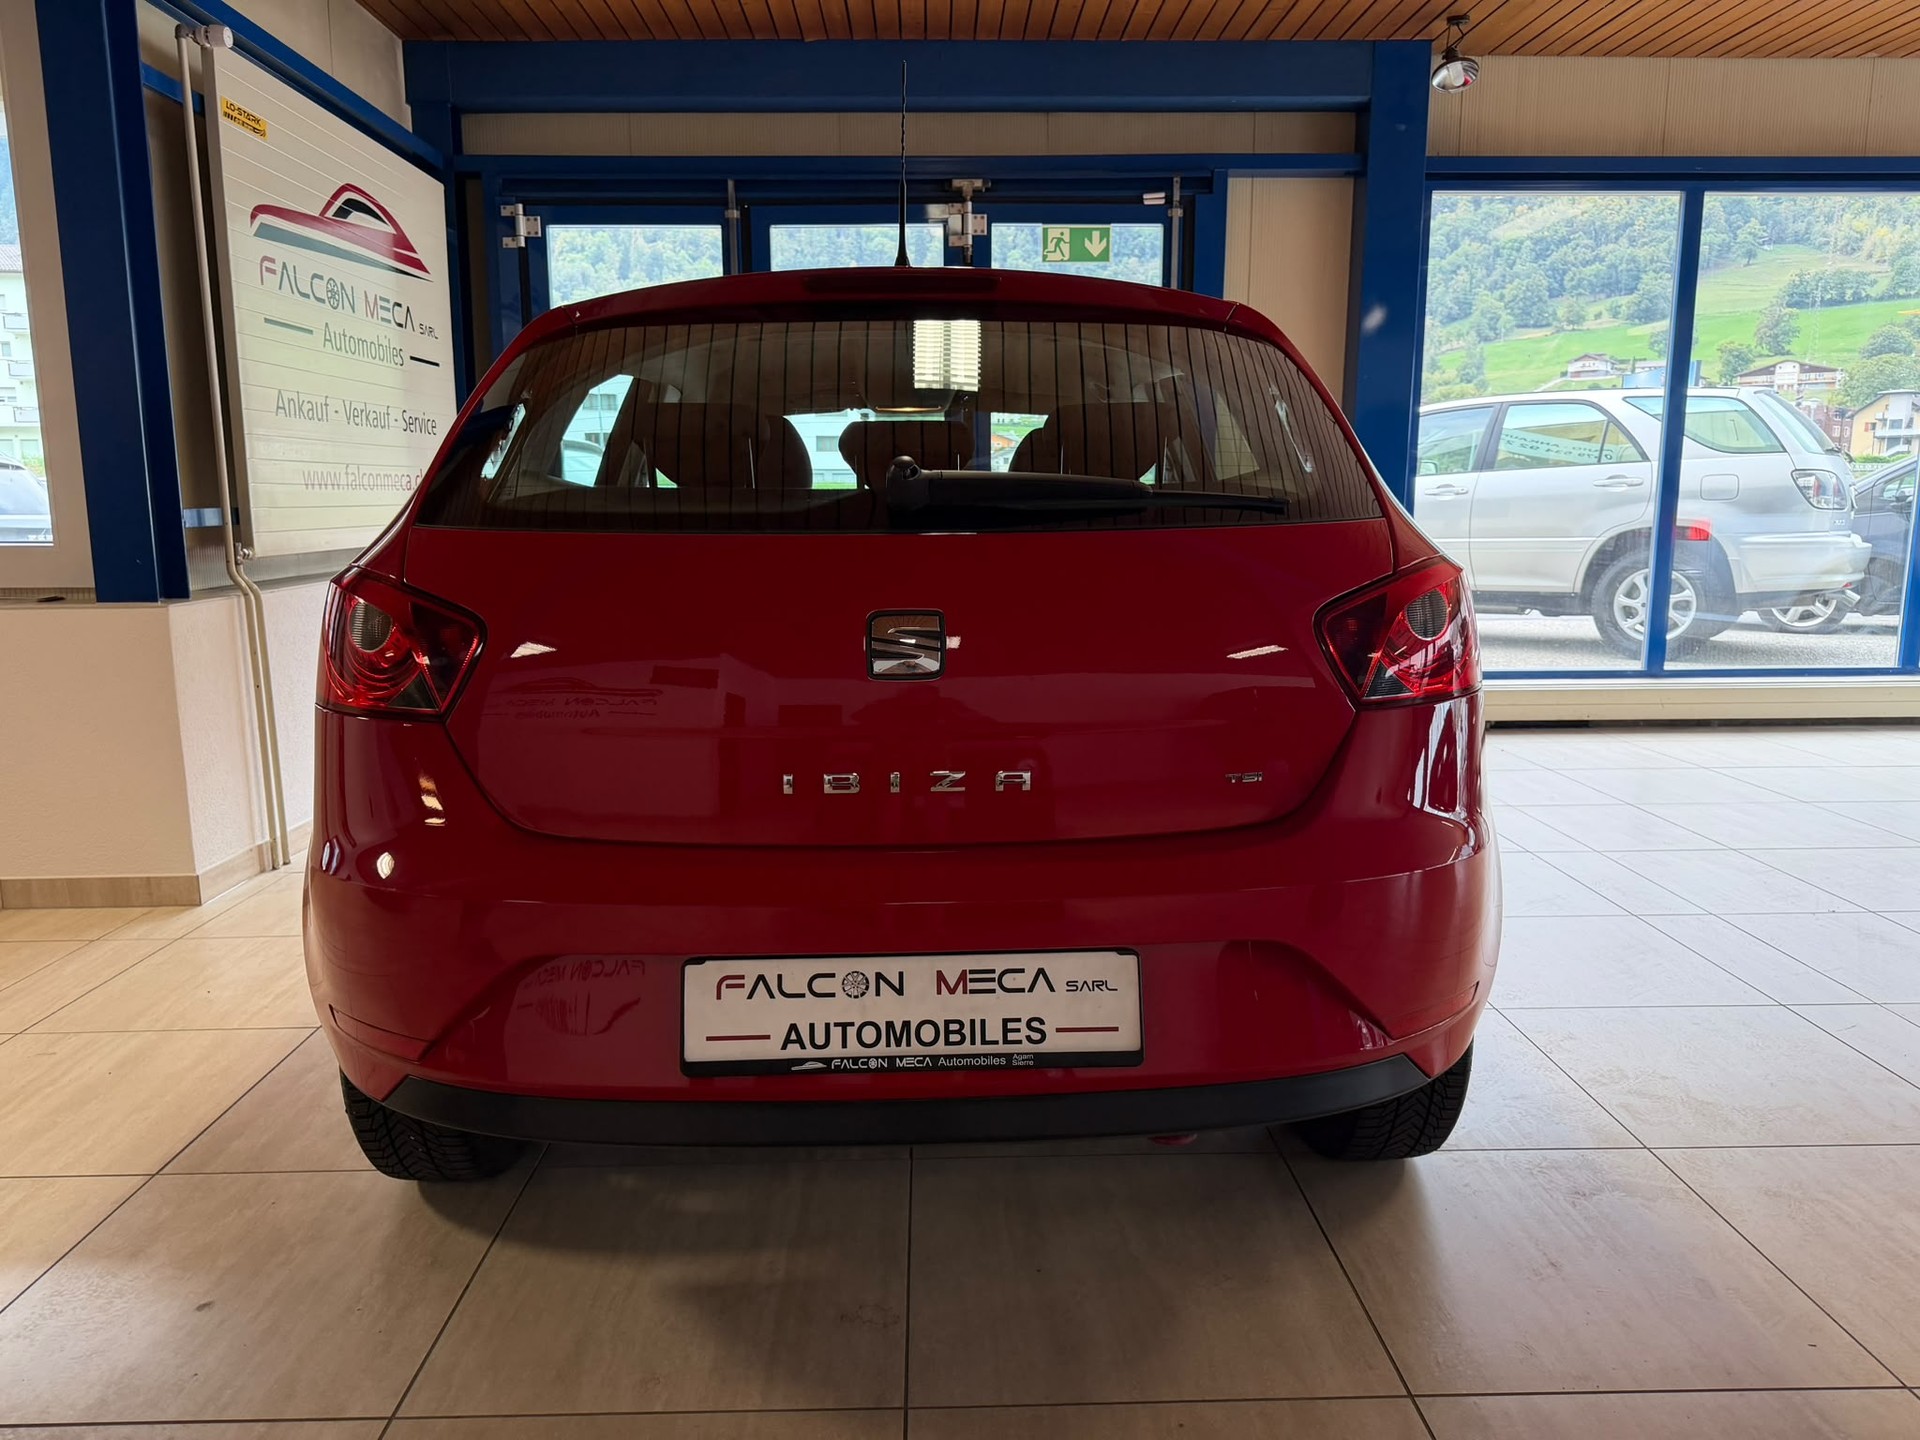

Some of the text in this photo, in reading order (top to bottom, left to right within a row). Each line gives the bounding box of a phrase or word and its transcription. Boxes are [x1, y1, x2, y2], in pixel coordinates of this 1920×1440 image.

[259, 255, 439, 340] FALCON MECA SARL
[322, 321, 405, 367] Automobiles
[275, 389, 330, 423] Ankauf
[343, 400, 391, 431] Verkauf
[401, 409, 437, 436] Service
[302, 464, 422, 492] www.falconmeca.c
[783, 770, 1031, 794] IBIZA
[1225, 771, 1263, 784] TSI
[716, 967, 1118, 1001] FALCON MECA SARL
[780, 1016, 1048, 1051] AUTOMOBILES
[831, 1055, 1006, 1070] FALCON MECA Automobiles
